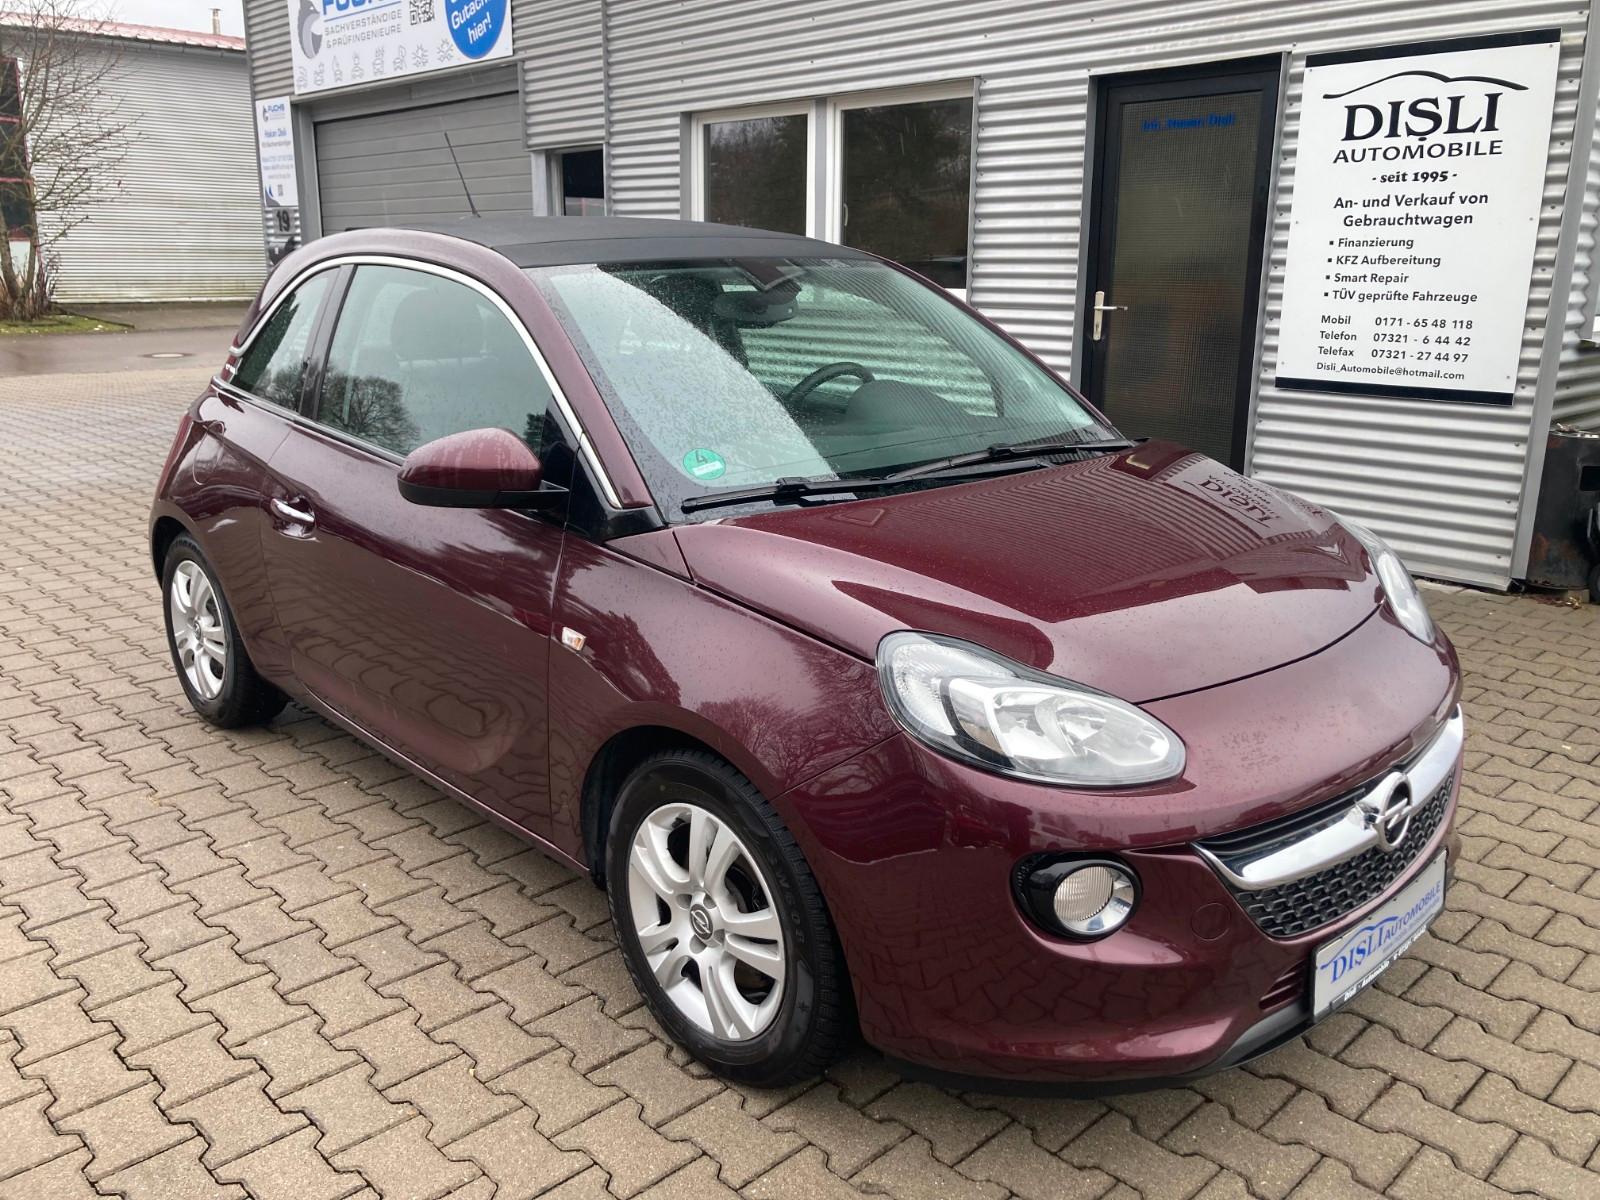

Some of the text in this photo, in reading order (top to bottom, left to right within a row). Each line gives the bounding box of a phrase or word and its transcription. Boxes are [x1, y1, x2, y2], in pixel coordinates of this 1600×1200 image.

[324, 9, 402, 36] SACHVERSTÄNDIGE
[467, 11, 492, 44] hier!
[1332, 139, 1504, 164] AUTOMOBILE
[1379, 171, 1409, 183] seit
[1411, 170, 1449, 183] 1995
[1333, 191, 1489, 209] An- und Verkauf von
[276, 209, 291, 232] 19
[1343, 212, 1473, 229] Gebrauchtwagen
[1338, 236, 1414, 250] Finanzierung
[1336, 254, 1441, 268] KFZ Aufbereitung
[1334, 272, 1409, 286] Smart Repair
[1332, 287, 1478, 305] TÜV geprüfte Fahrzeuge
[1321, 314, 1351, 325] Mobil
[1375, 316, 1403, 327] 0171
[1413, 318, 1428, 328] 65
[1431, 319, 1447, 329] 48
[1452, 319, 1473, 330] 118
[1319, 330, 1357, 341] Telefon
[1373, 332, 1408, 344] 07321
[1422, 335, 1430, 345] 6
[1434, 335, 1450, 345] 44
[1455, 336, 1471, 346] 42
[1318, 345, 1354, 357] Telefax
[1371, 348, 1406, 360] 07321
[1416, 351, 1432, 361] 27
[1434, 352, 1450, 362] 44
[1453, 353, 1469, 363] 97
[1316, 362, 1466, 381] Disli_Automobile@hotmail.com
[1383, 879, 1442, 943] AUTOMOBILE
